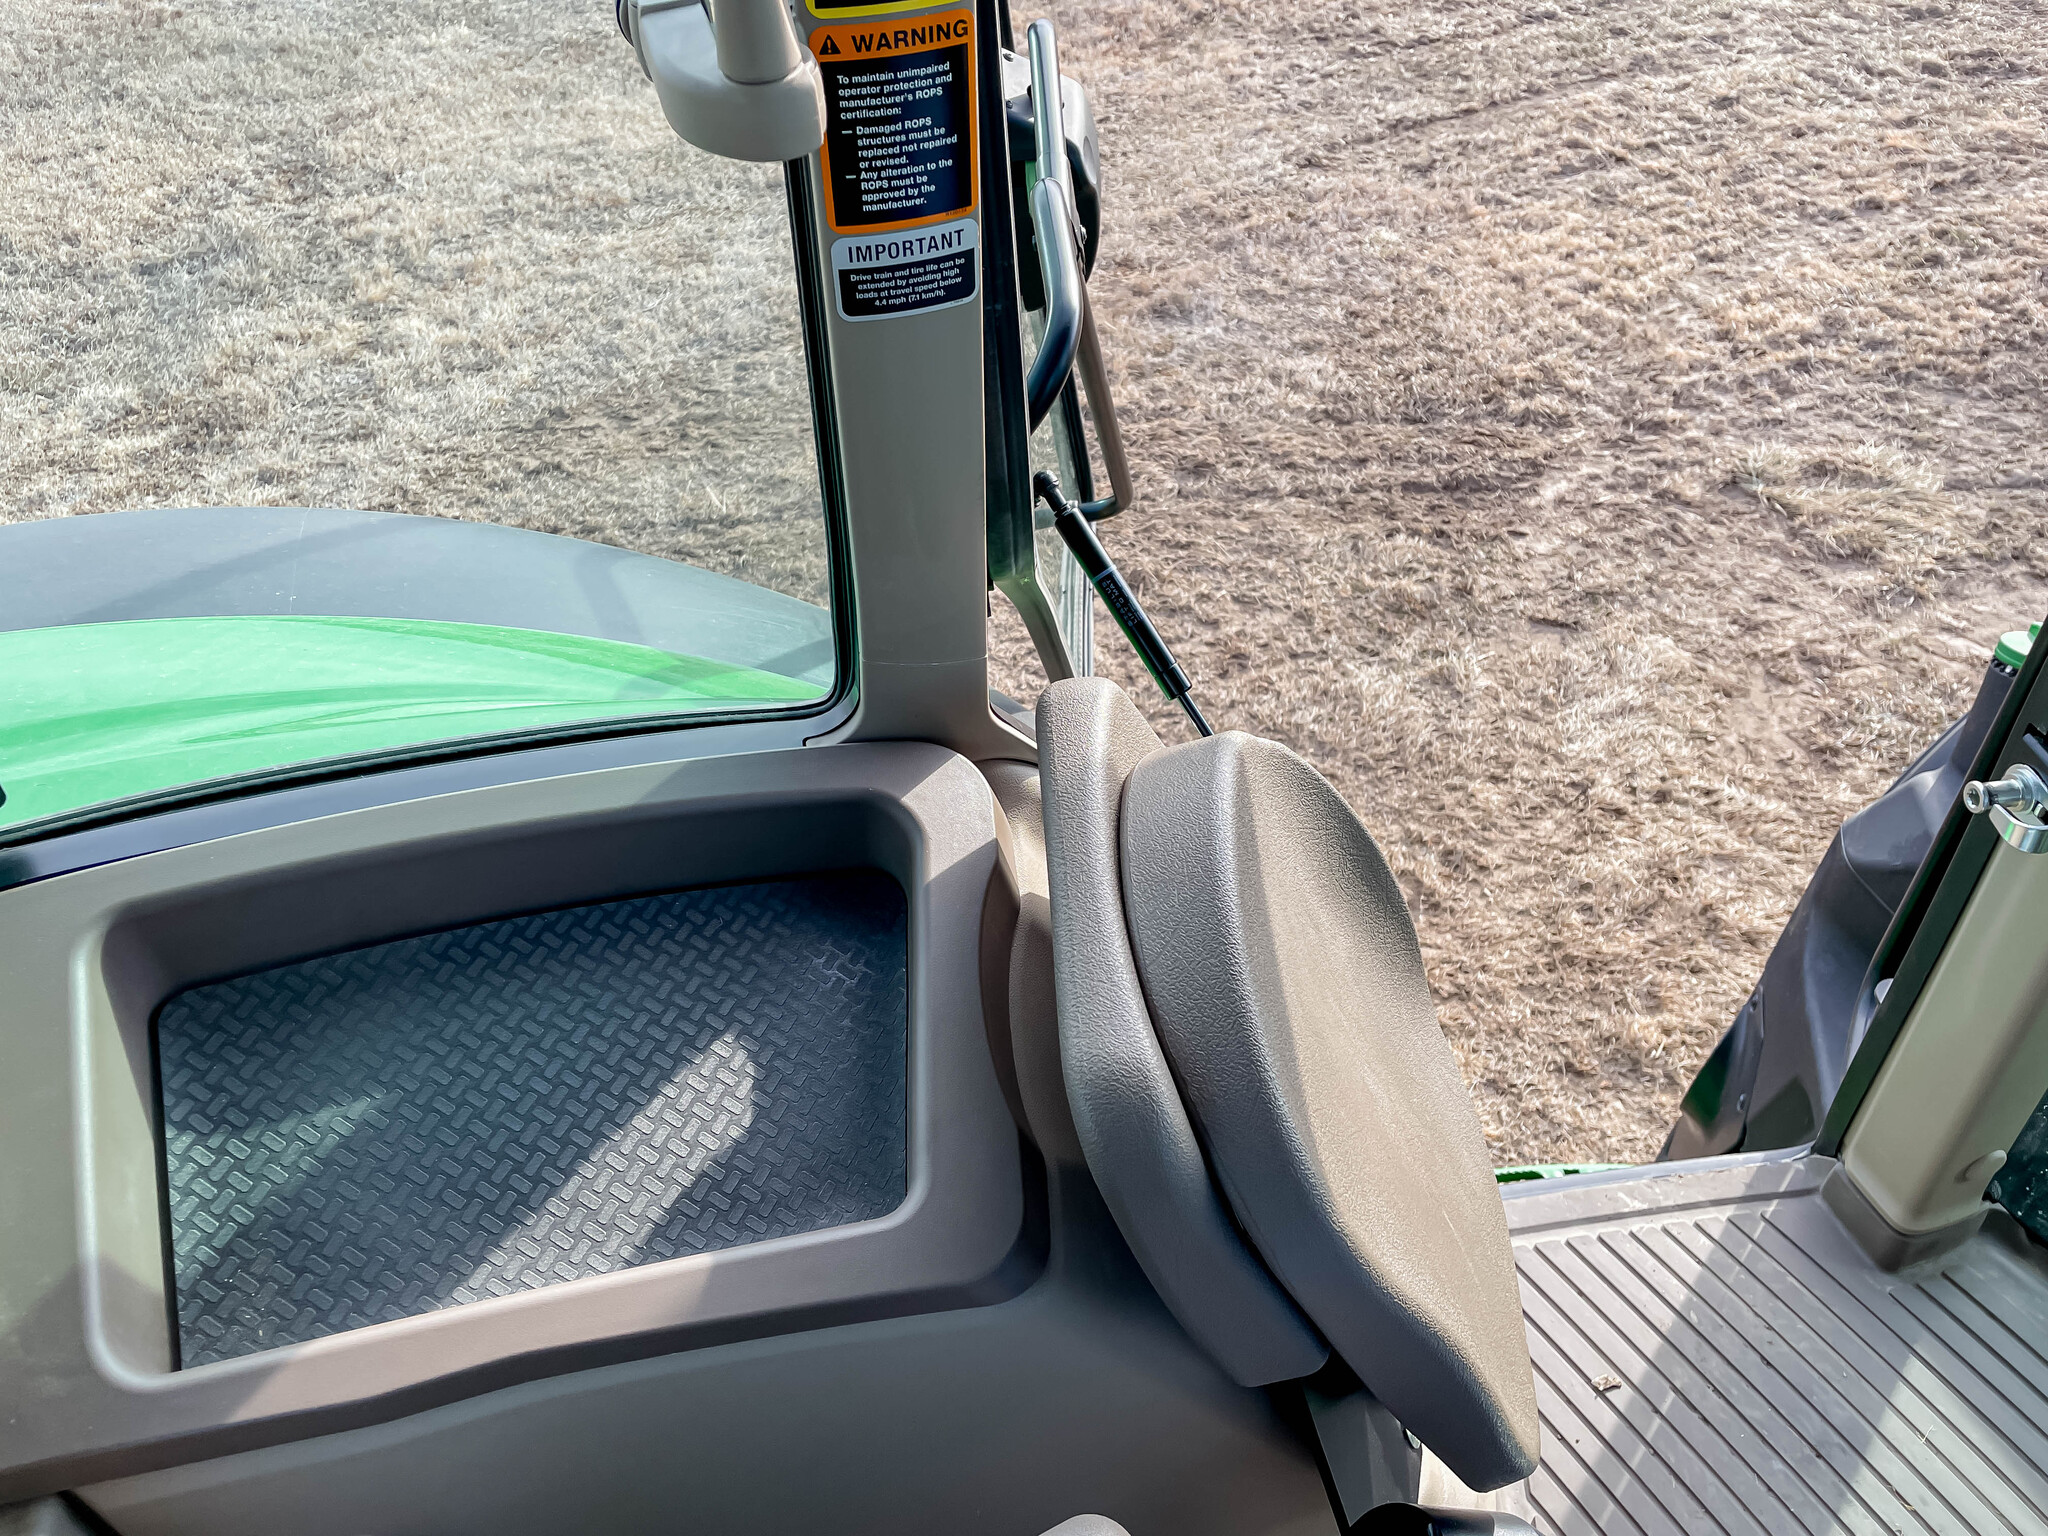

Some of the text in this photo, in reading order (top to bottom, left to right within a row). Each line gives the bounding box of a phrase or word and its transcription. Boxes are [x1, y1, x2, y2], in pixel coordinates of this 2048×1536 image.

[851, 19, 968, 53] WARNING
[837, 62, 950, 84] To maintain unimpaired
[839, 73, 952, 97] operator protection and
[840, 87, 943, 107] manufacturer's ROPS
[841, 107, 902, 119] certification:
[856, 117, 931, 135] Damaged ROPS
[858, 127, 945, 146] structures must be
[859, 135, 957, 158] replaced not repaired
[860, 171, 878, 180] Any
[881, 166, 924, 178] alteration
[939, 159, 952, 167] the
[872, 156, 908, 167] revised.
[861, 175, 927, 190] ROPS must be
[862, 184, 935, 201] approved by the
[863, 197, 927, 211] manufacturer.
[848, 229, 964, 263] IMPORTANT
[850, 274, 871, 282] Drive
[874, 271, 892, 280] train
[895, 269, 909, 277] and
[911, 267, 924, 275] tire
[926, 264, 938, 272] life
[940, 261, 953, 269] can
[858, 268, 959, 289] extended by avoiding high
[856, 291, 878, 299] loads
[890, 287, 912, 295] travel
[915, 282, 938, 292] speed
[940, 276, 962, 287] below
[889, 297, 906, 305] mph
